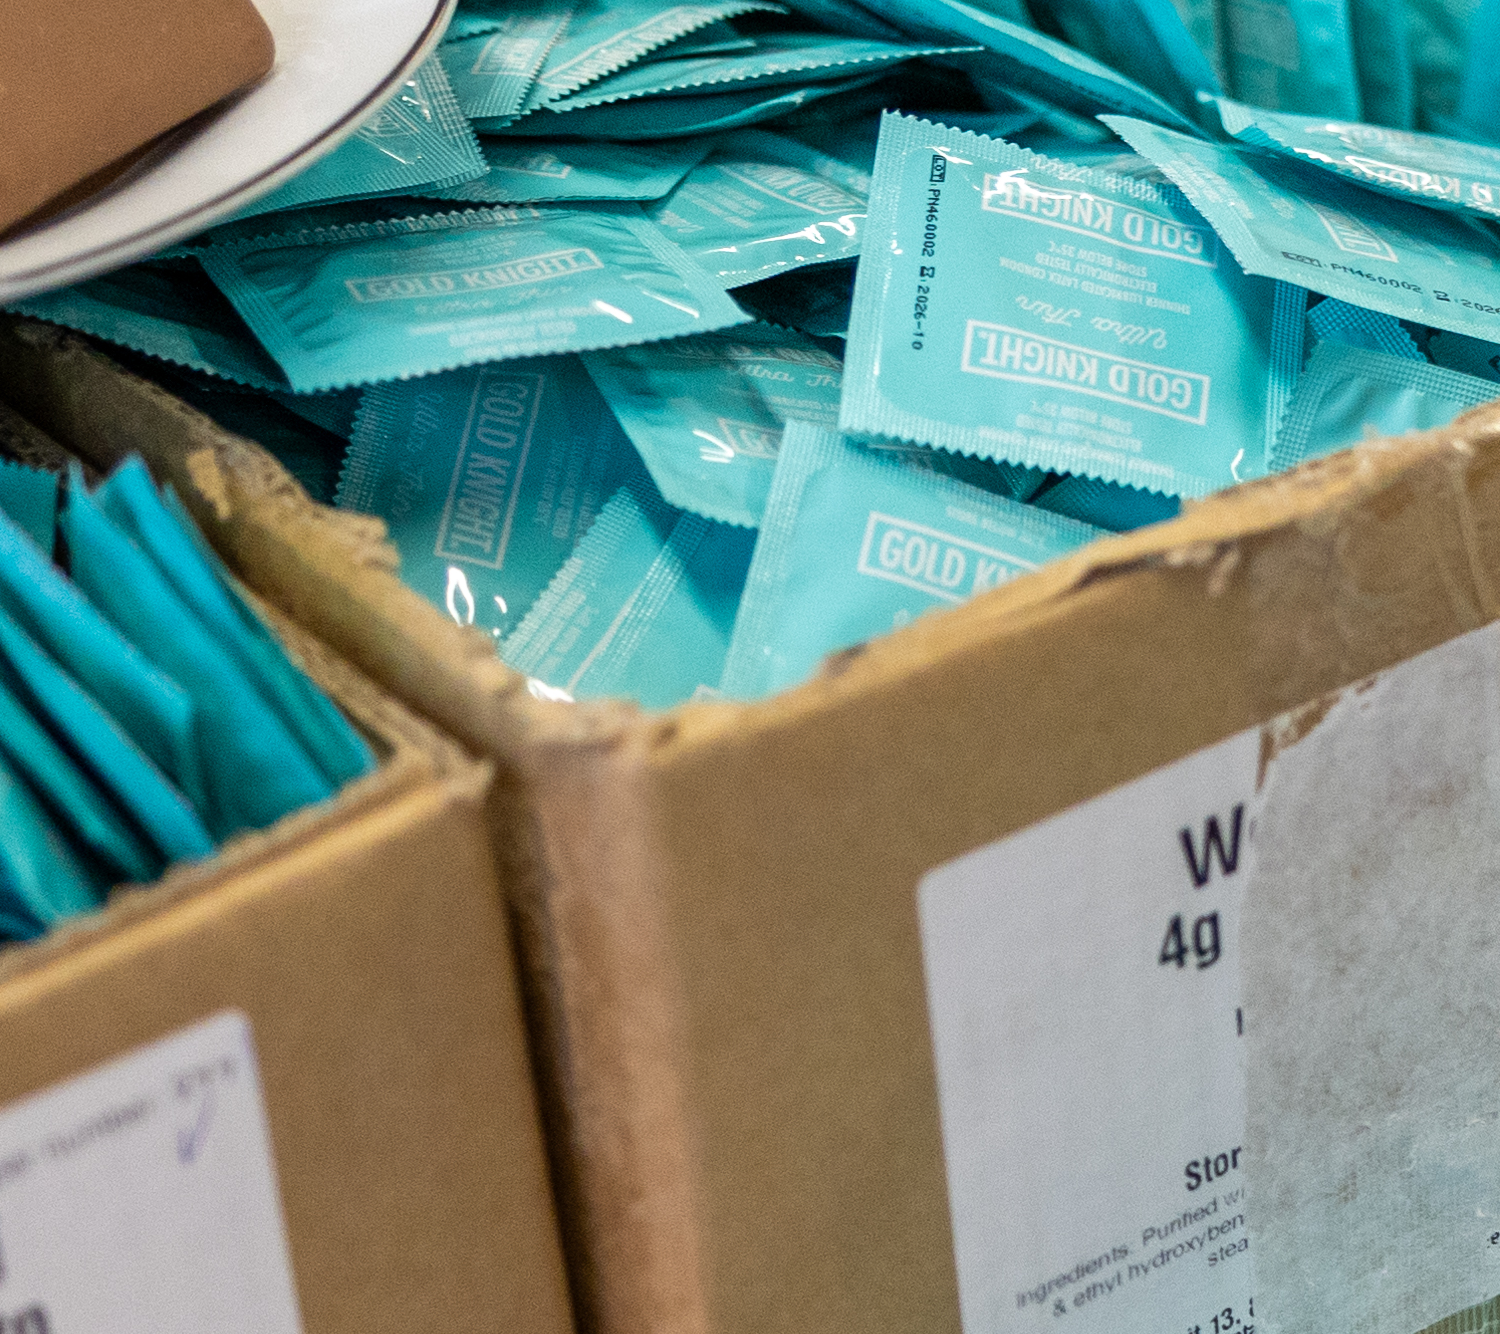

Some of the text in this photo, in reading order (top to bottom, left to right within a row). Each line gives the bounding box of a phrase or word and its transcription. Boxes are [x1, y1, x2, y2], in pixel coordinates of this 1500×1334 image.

[918, 186, 942, 257] PN460002
[1119, 210, 1205, 253] GOLD
[997, 256, 1191, 315] THINNER LUBRICATED LATEX CONDOM
[1033, 251, 1157, 293] ELECTRONICALLY TESTED
[1076, 247, 1114, 268] BELOW
[1115, 257, 1148, 277] STORE
[366, 270, 455, 303] GOLD
[908, 282, 932, 350] 2026-10
[1011, 293, 1168, 350] Ultra Thin
[472, 376, 529, 452] GOLD
[1105, 361, 1194, 410] GOLD
[874, 526, 970, 590] GOLD
[1154, 894, 1222, 989] 4g
[1183, 1137, 1243, 1195] Stor
[1142, 1195, 1218, 1248] Purified
[1206, 1231, 1249, 1268] stea
[1073, 1269, 1122, 1309] ethyl
[1127, 1211, 1244, 1285] hydroxyben
